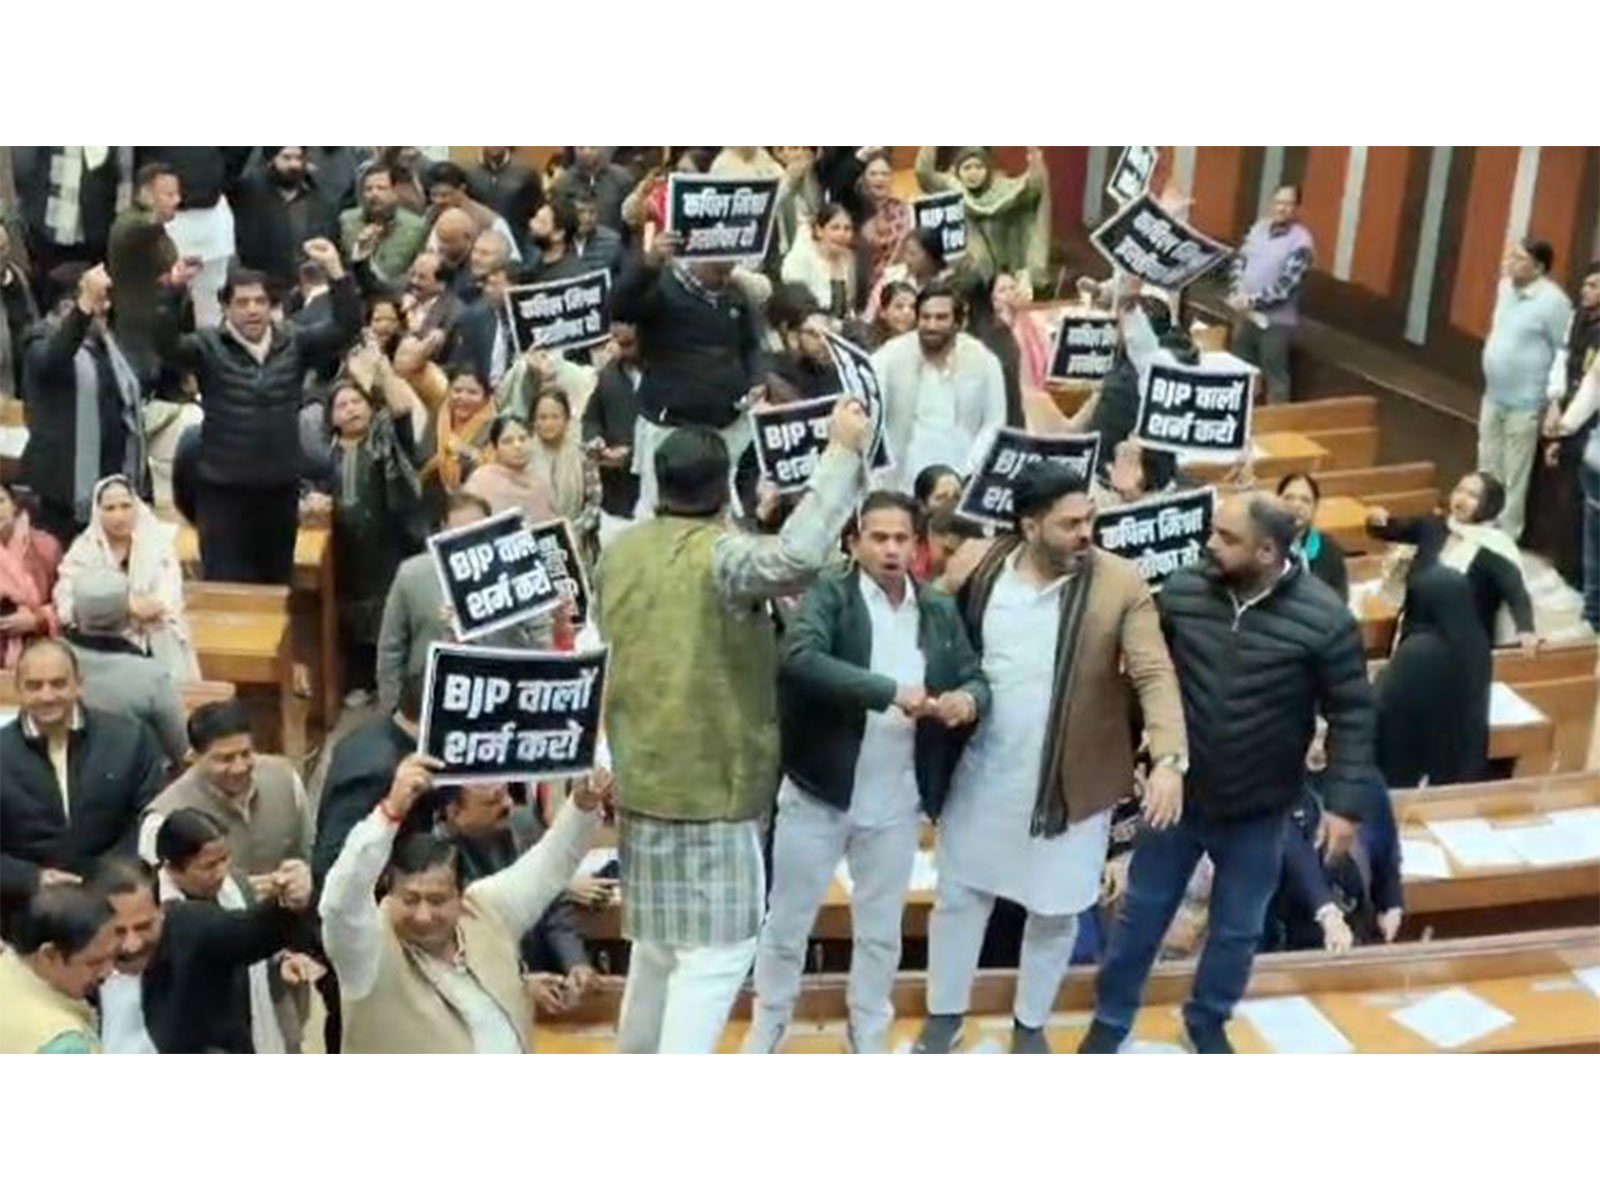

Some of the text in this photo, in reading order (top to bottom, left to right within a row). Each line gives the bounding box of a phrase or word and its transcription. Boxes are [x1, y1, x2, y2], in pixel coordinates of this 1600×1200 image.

[1151, 377, 1246, 412] BJP वालों
[763, 420, 807, 452] BJP
[1147, 411, 1238, 444] शर्म करो
[1100, 516, 1157, 550] कपिल
[449, 542, 495, 582] BJP
[466, 571, 514, 621] शर्म
[511, 559, 552, 602] करो
[442, 665, 600, 720] BJP वालों
[444, 718, 584, 766] शर्म करो
